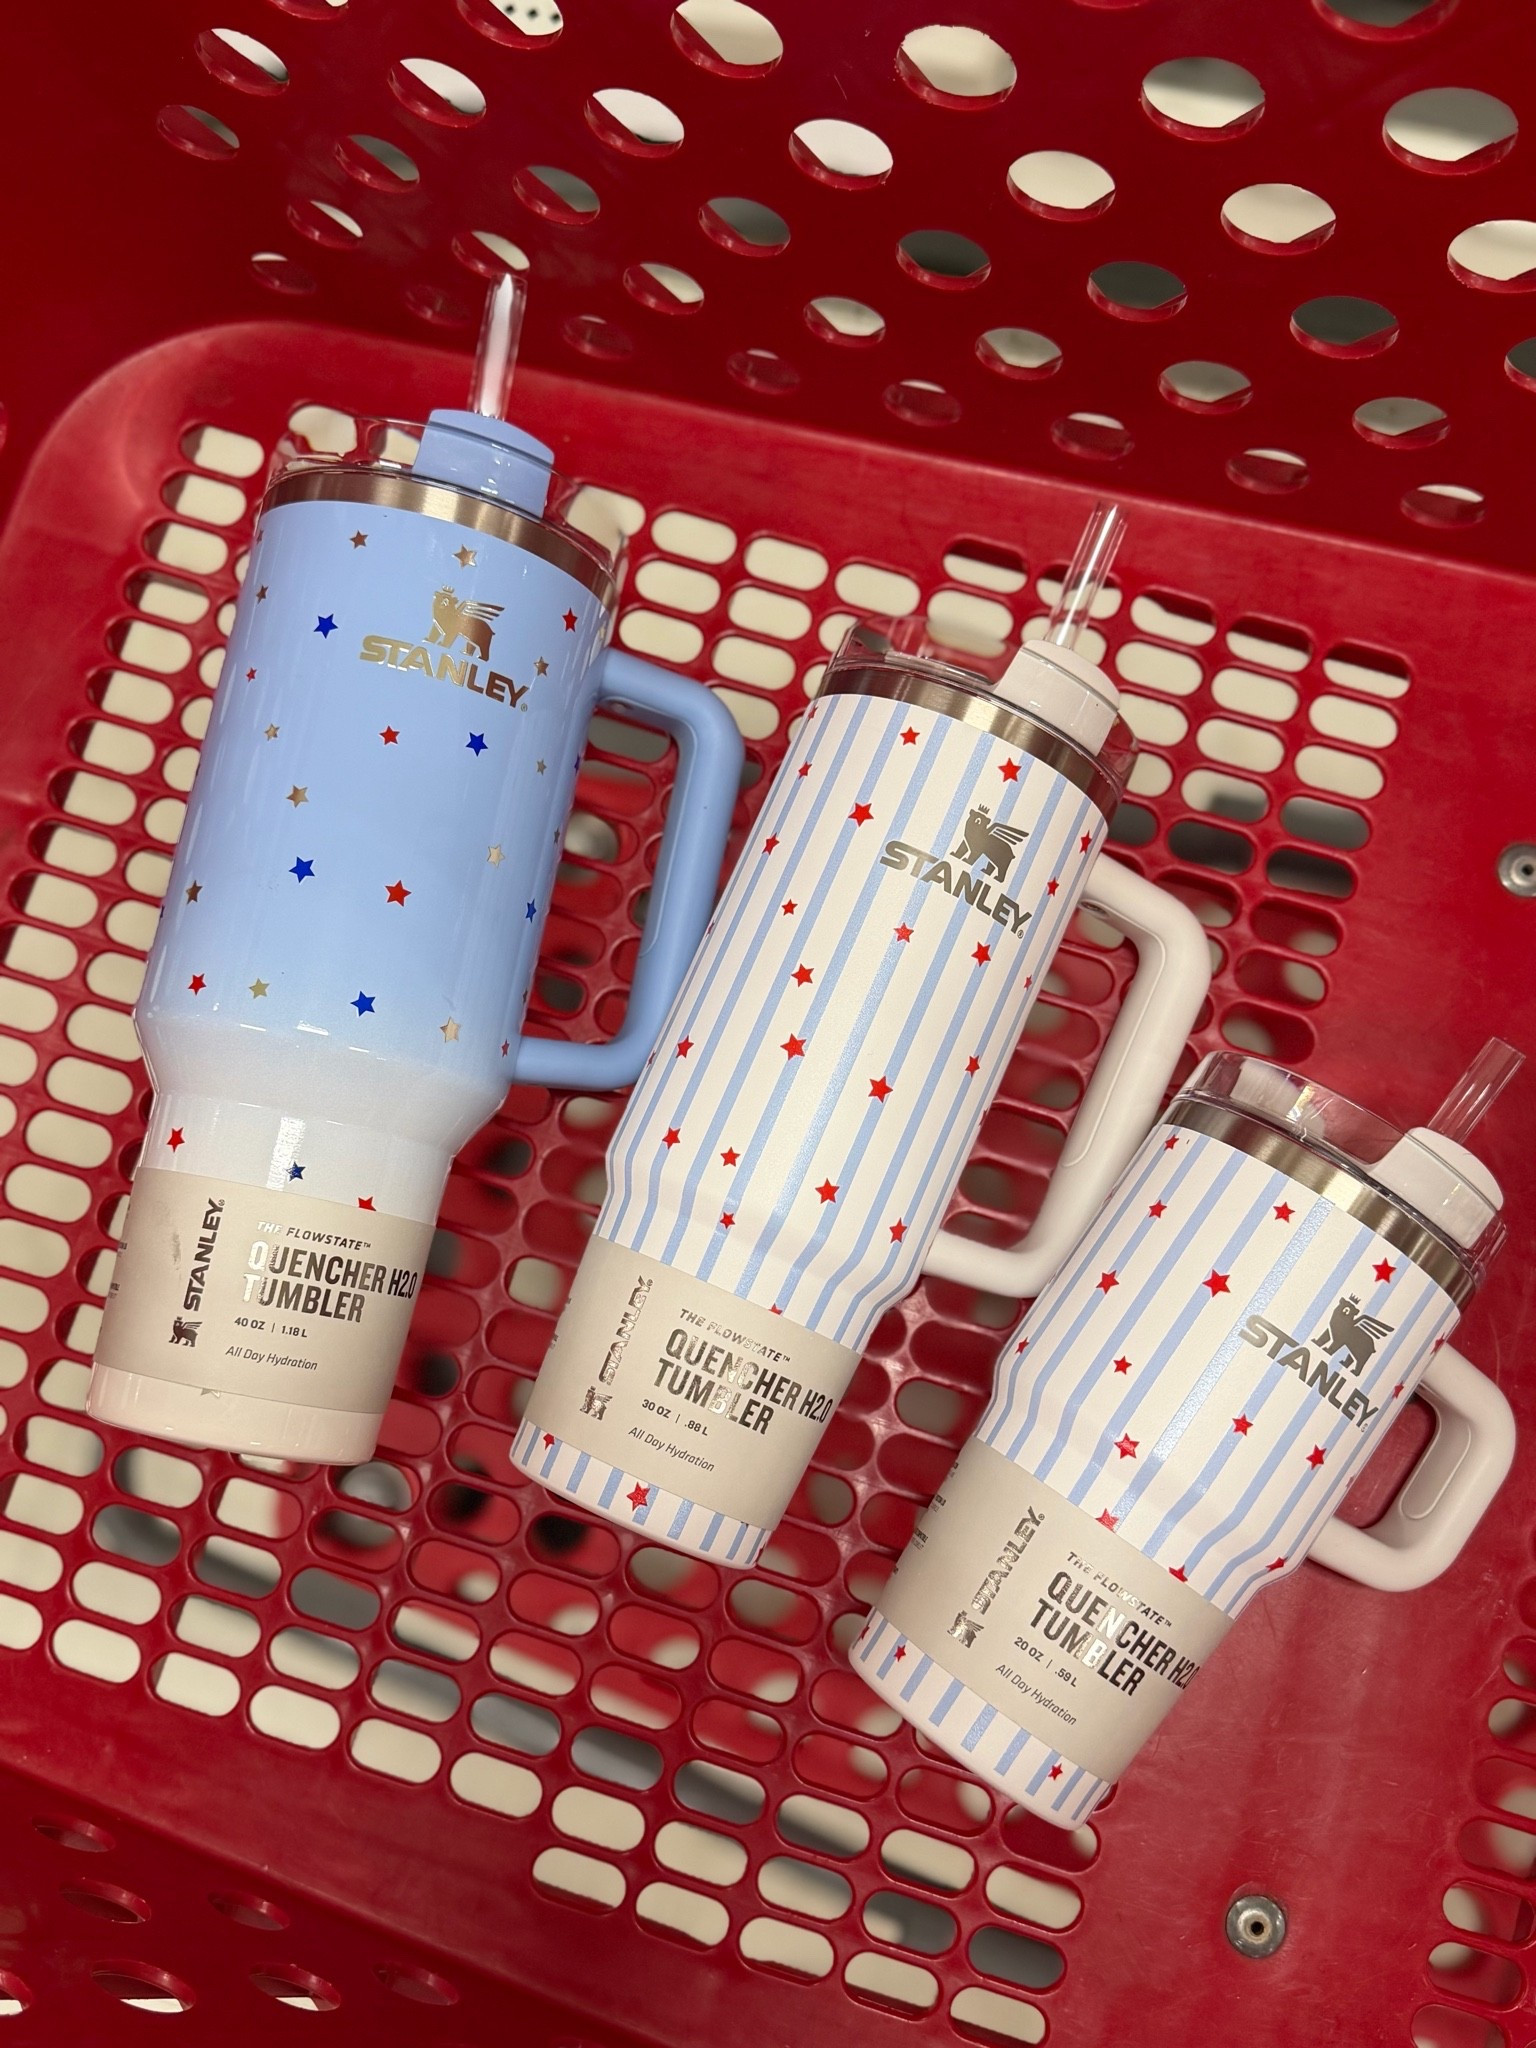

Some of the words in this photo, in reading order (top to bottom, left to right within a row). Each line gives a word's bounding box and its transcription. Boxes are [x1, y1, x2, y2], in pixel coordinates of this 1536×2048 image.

[257, 1220, 283, 1234] THE
[247, 1239, 387, 1295] QUENCHER
[242, 1272, 366, 1323] TUMBLER
[679, 1308, 706, 1328] THE
[234, 1316, 249, 1327] 40
[250, 1319, 266, 1331] OZ
[281, 1325, 301, 1337] 1.18
[300, 1328, 308, 1338] L
[225, 1345, 243, 1358] All
[243, 1348, 266, 1364] Day
[266, 1353, 318, 1371] Hydration
[665, 1328, 803, 1411] QUENCHER
[641, 1398, 656, 1411] 30
[656, 1405, 672, 1419] OZ
[684, 1420, 702, 1432] .88
[701, 1426, 708, 1436] L
[653, 1357, 775, 1435] TUMBLER
[628, 1427, 646, 1440] All
[644, 1433, 666, 1451] Day
[665, 1443, 715, 1472] Hydration
[1066, 1551, 1094, 1575] THE
[1029, 1597, 1146, 1697] TUMBLER
[1047, 1571, 1177, 1676] QUENCHER
[1013, 1636, 1029, 1651] 20
[1028, 1647, 1044, 1662] OZ
[1054, 1667, 1072, 1682] .59
[1070, 1676, 1077, 1688] L
[995, 1664, 1014, 1679] All
[1010, 1674, 1032, 1694] Day
[1030, 1688, 1077, 1725] Hydration
